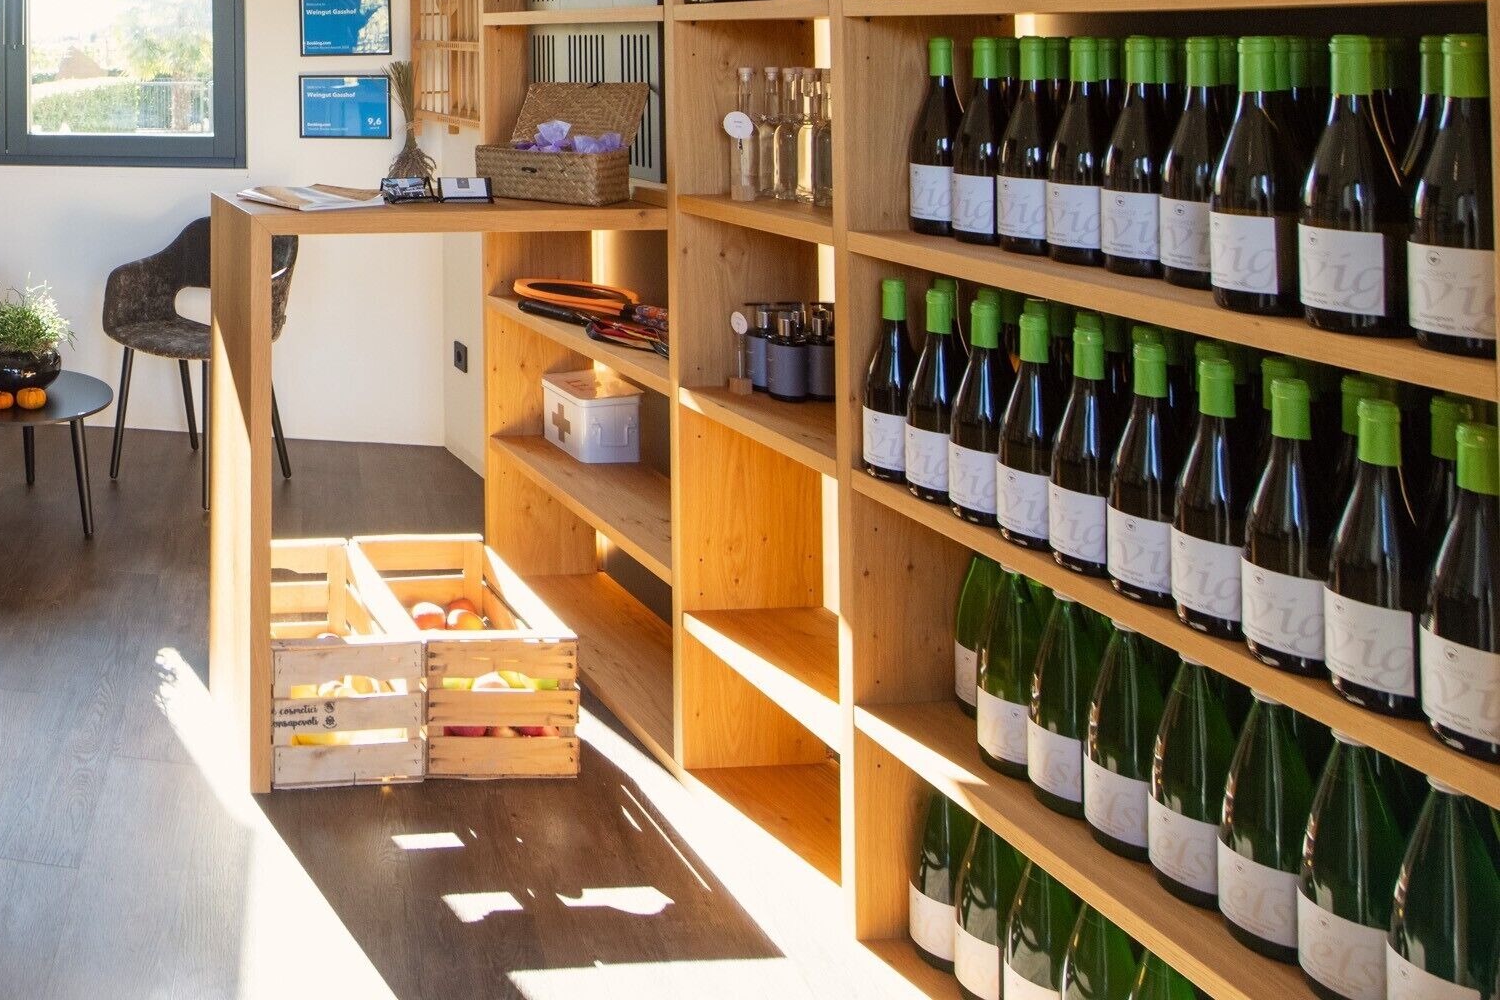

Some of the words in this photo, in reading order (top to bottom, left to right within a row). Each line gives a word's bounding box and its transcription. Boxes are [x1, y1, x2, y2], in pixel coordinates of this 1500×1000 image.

[367, 117, 381, 126] 9,6
[279, 705, 318, 716] cosmetici
[272, 716, 319, 730] onsapevoli
